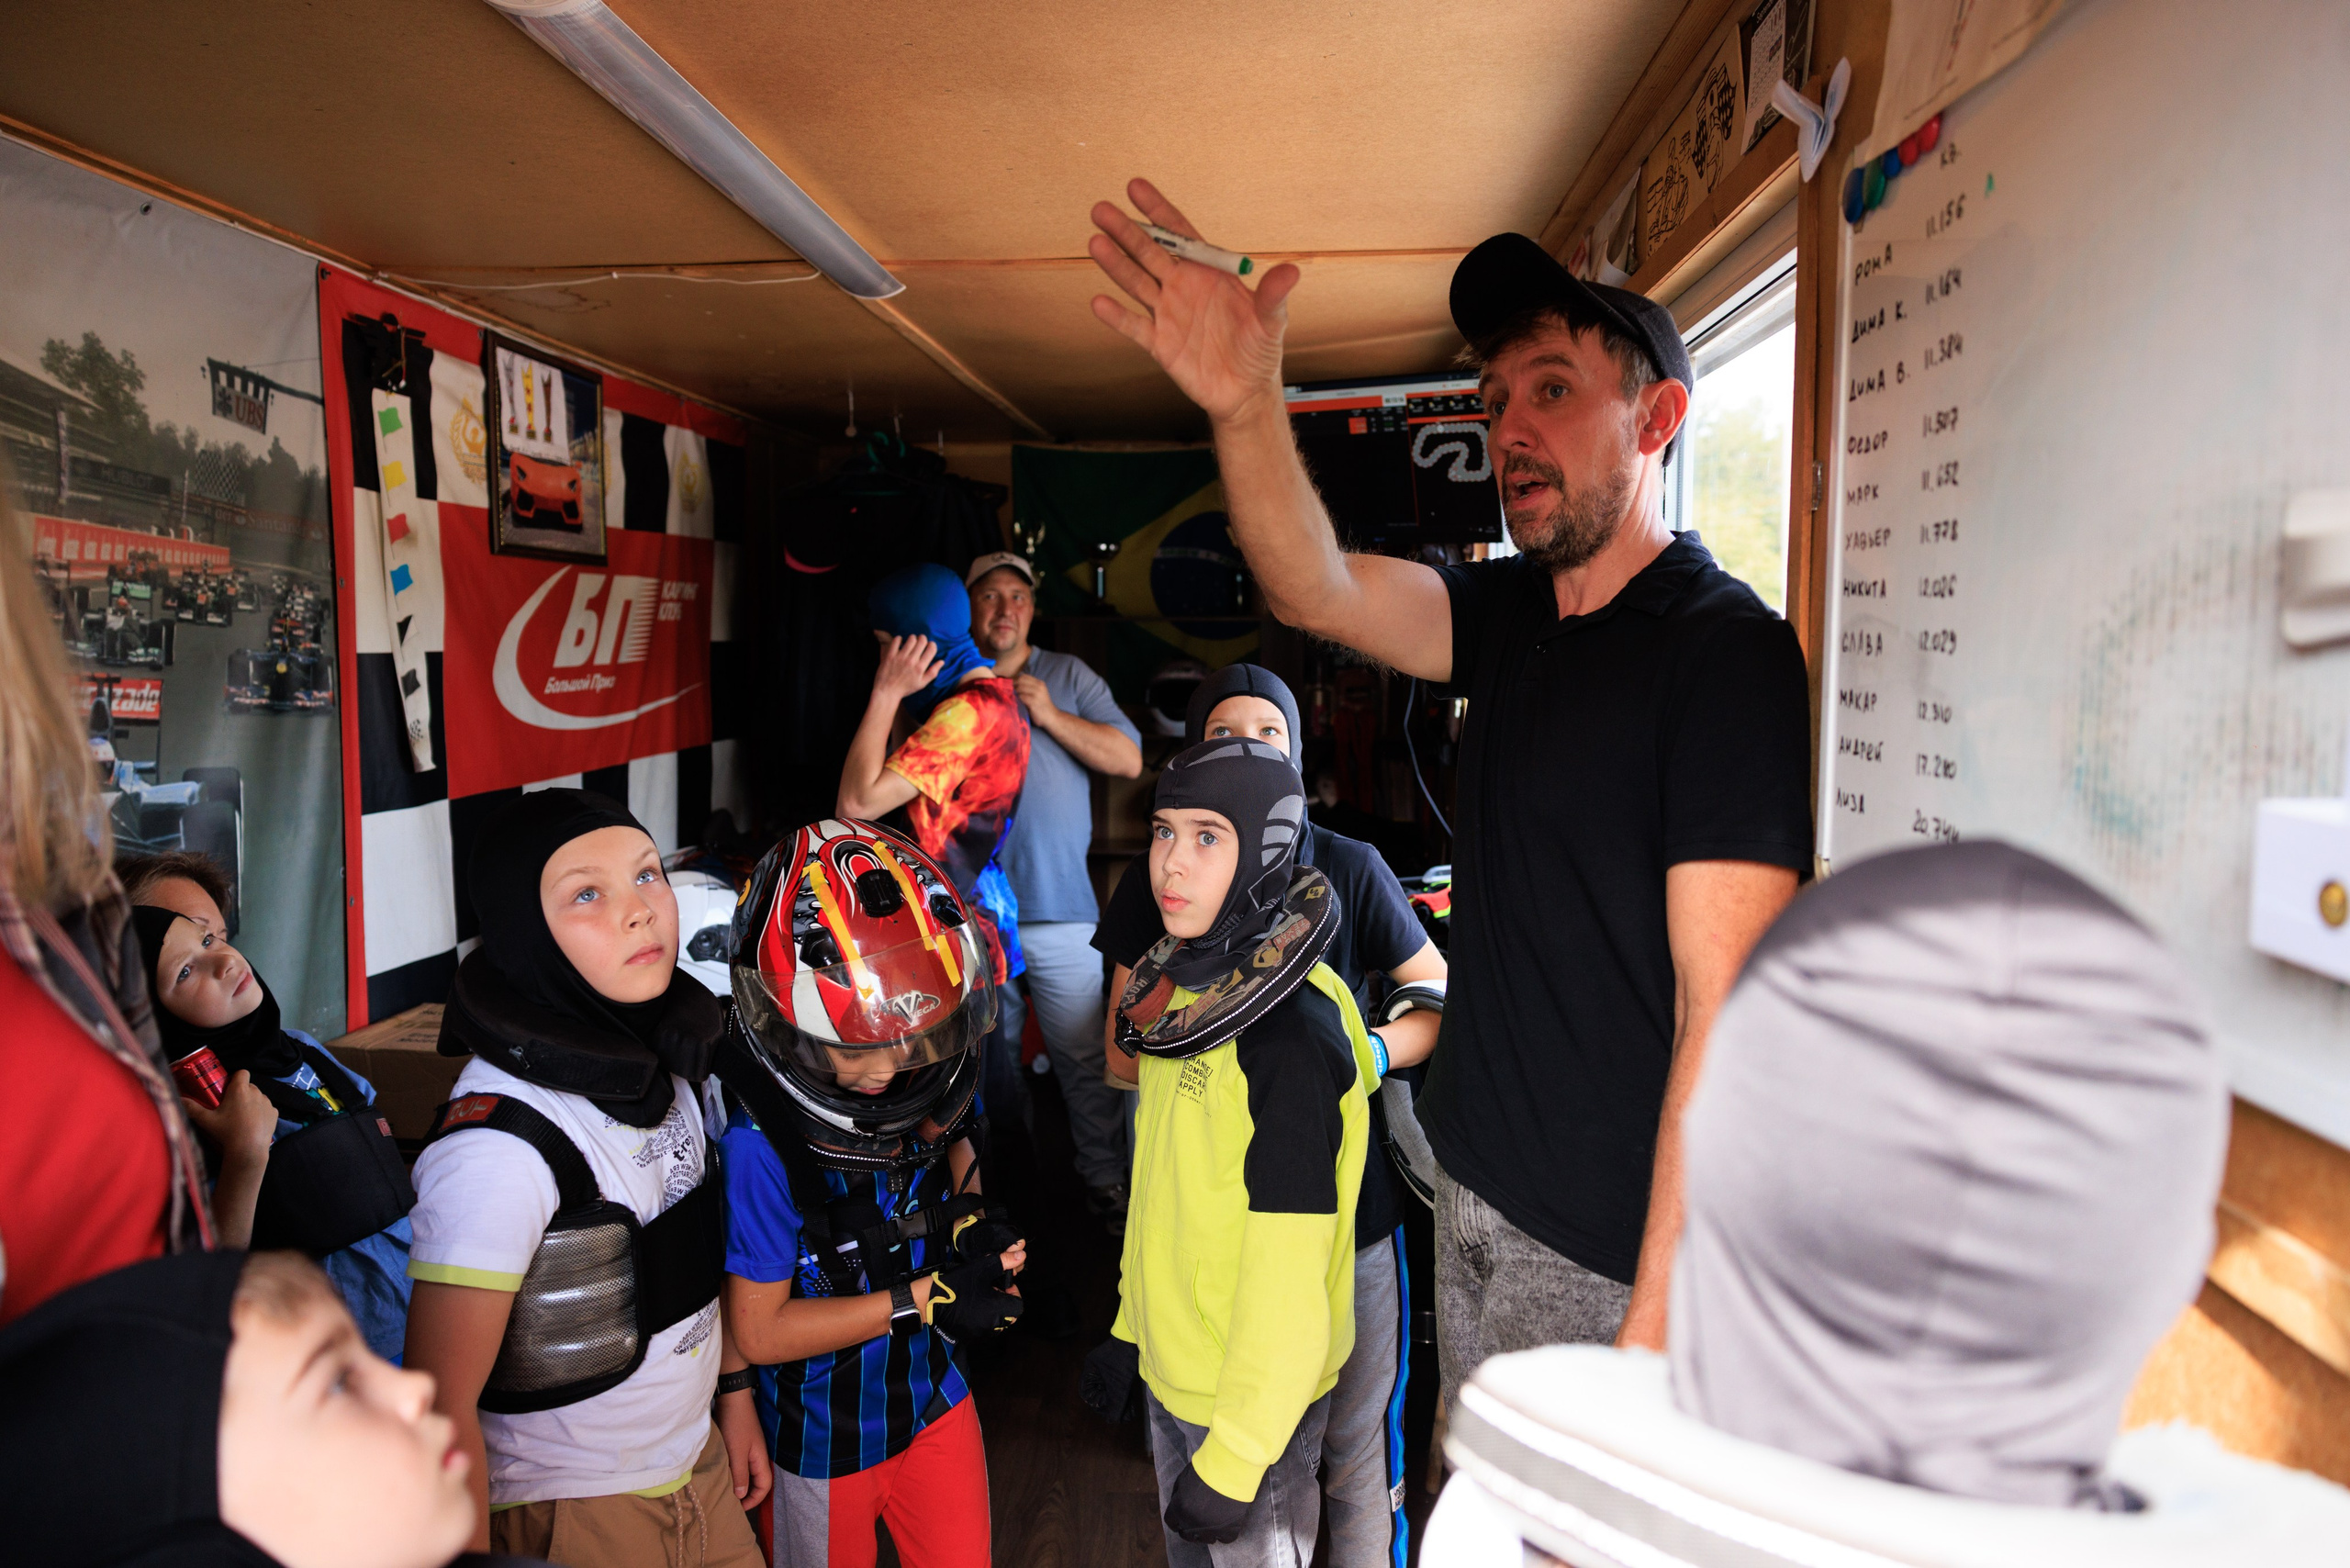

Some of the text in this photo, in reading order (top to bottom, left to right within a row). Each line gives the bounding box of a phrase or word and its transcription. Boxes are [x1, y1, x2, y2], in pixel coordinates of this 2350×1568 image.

[1855, 244, 1892, 286] РОМА
[1852, 308, 1885, 342] ДИМА
[1850, 369, 1886, 401] ДИМА
[235, 395, 265, 429] UBS
[1847, 484, 1879, 505] МАРК
[1845, 528, 1891, 551] ХАВЬЕР
[1843, 578, 1886, 598] НИКИТА
[553, 572, 659, 668] БП
[1842, 629, 1883, 655] СЛАВА
[544, 674, 616, 694] Большой Приз
[1840, 689, 1877, 712] МАКАР
[1836, 787, 1865, 814] ЛИЗА
[909, 1003, 935, 1018] VEGA
[1179, 1081, 1203, 1098] APPLY
[673, 1134, 692, 1161] t-rex
